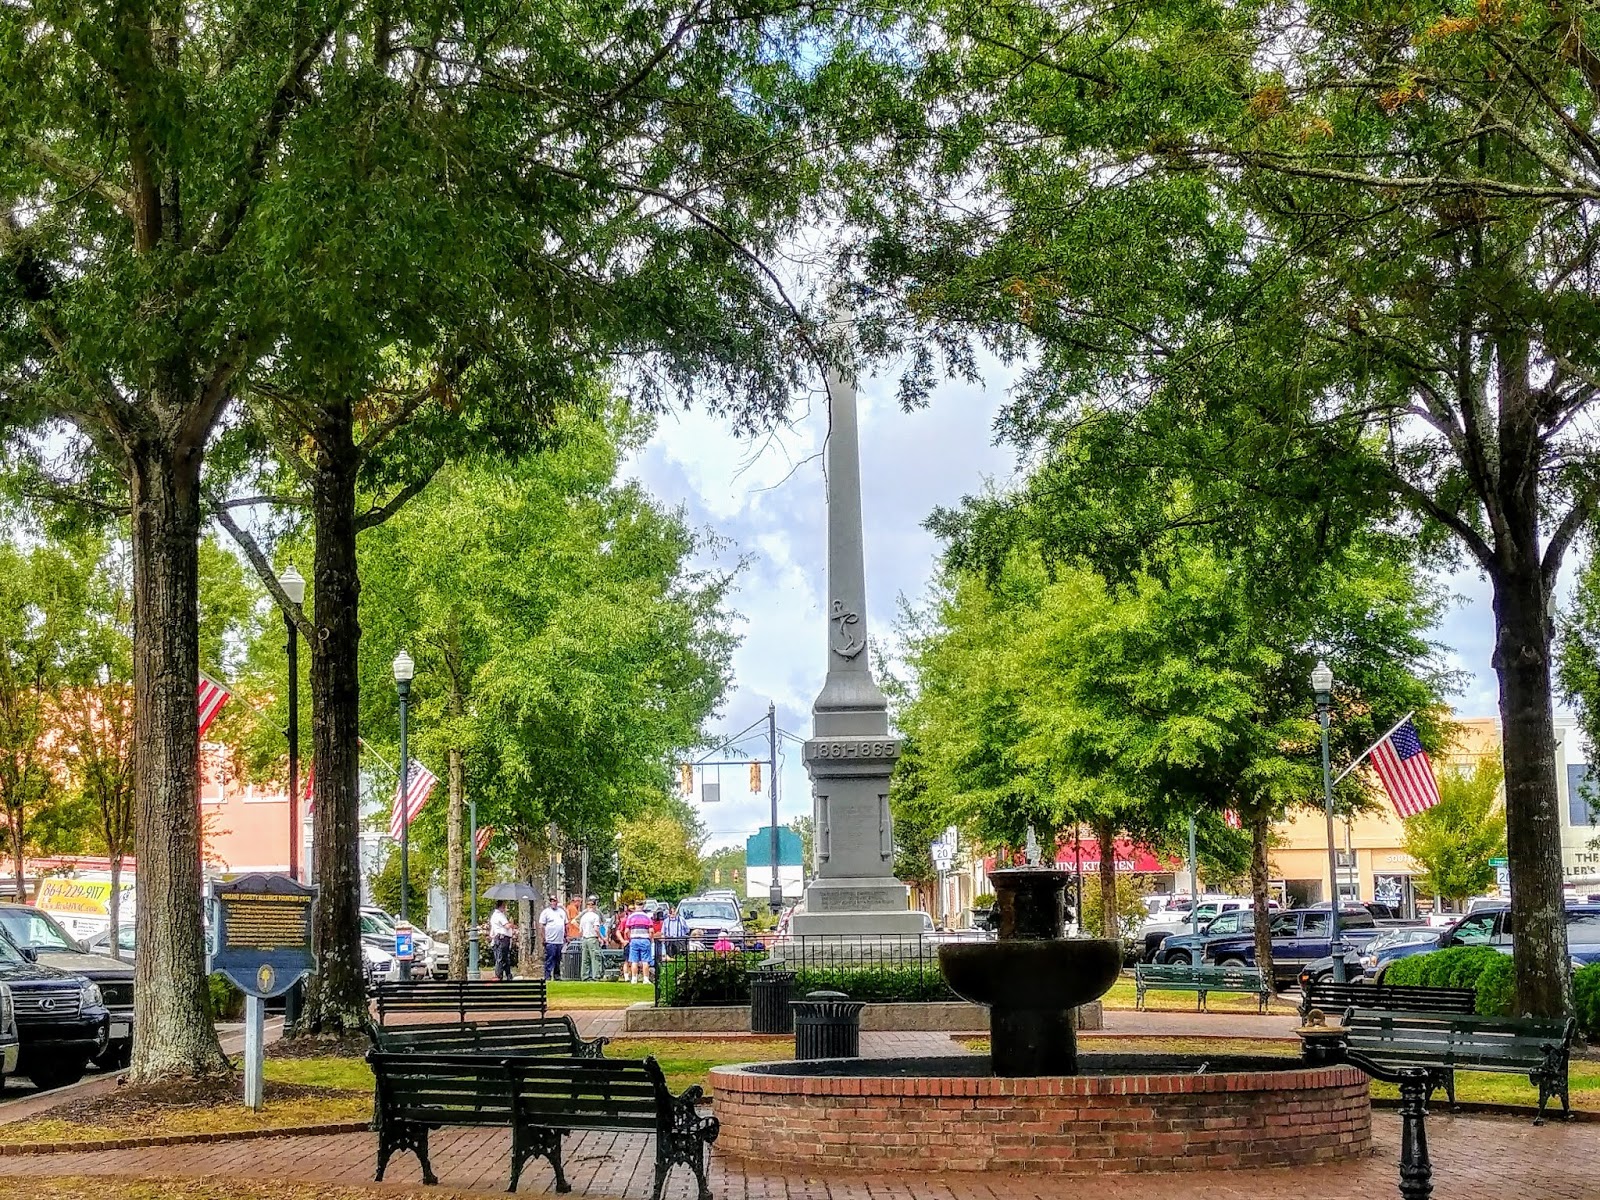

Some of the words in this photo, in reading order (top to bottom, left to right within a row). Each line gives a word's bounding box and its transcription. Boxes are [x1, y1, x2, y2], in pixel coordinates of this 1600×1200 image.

[813, 741, 895, 758] 1861-1865
[937, 849, 949, 859] 20
[1575, 853, 1599, 863] THE
[1052, 861, 1078, 872] HINA
[1082, 860, 1136, 871] KITEN
[43, 883, 105, 900] 864-229-9117
